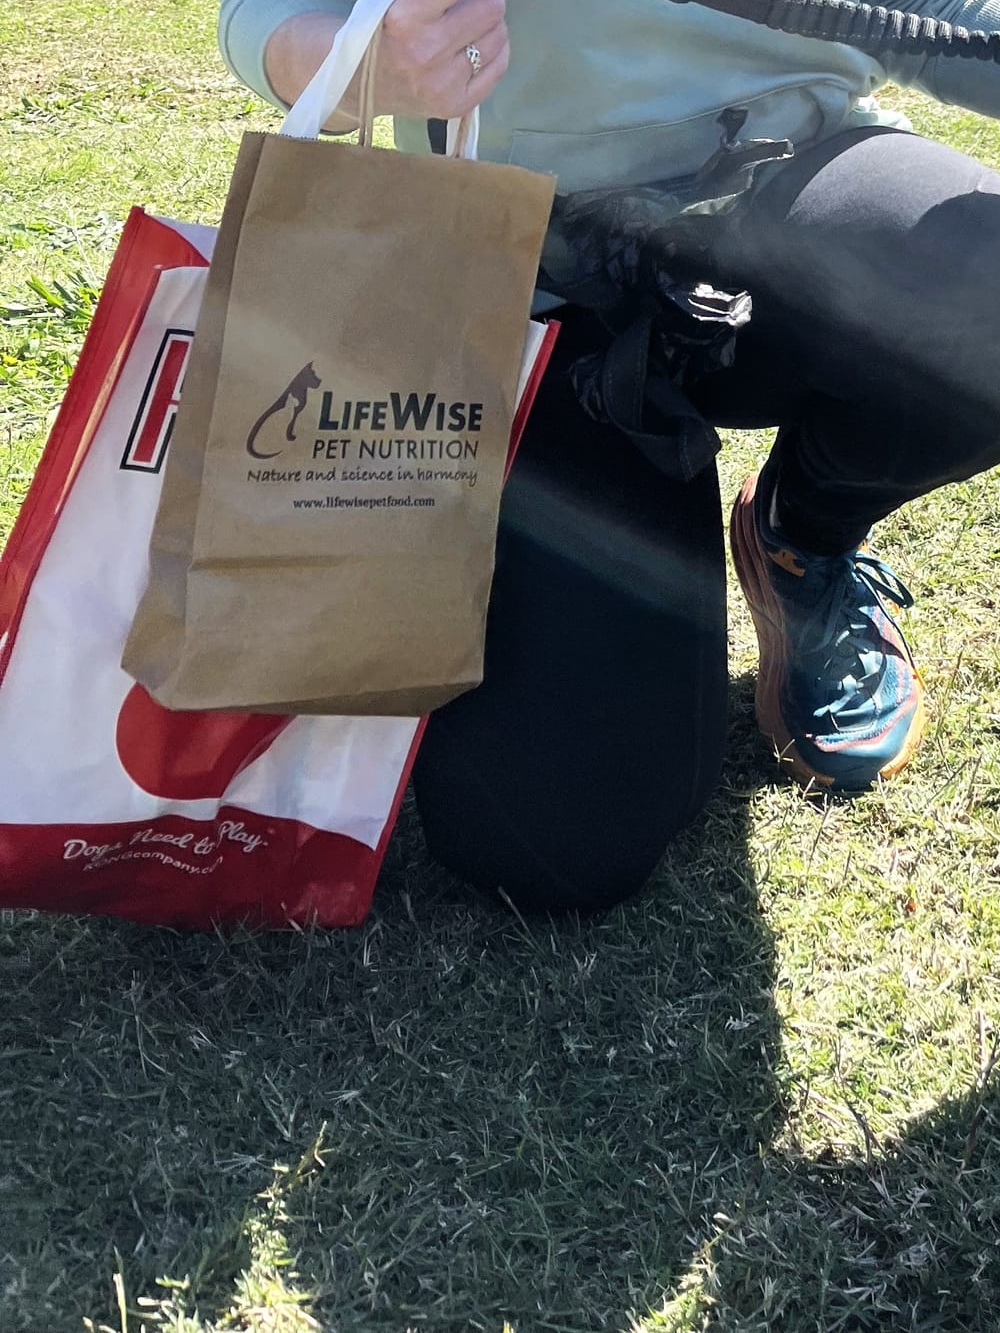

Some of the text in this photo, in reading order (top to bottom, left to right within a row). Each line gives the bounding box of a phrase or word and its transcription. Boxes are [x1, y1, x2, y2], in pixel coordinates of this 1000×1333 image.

[312, 439, 479, 460] PET NUTRITION
[247, 466, 478, 486] Nature and science in harmony
[293, 496, 436, 509] www.lifewisepetfood.com
[129, 828, 194, 848] Need
[193, 837, 215, 854] to
